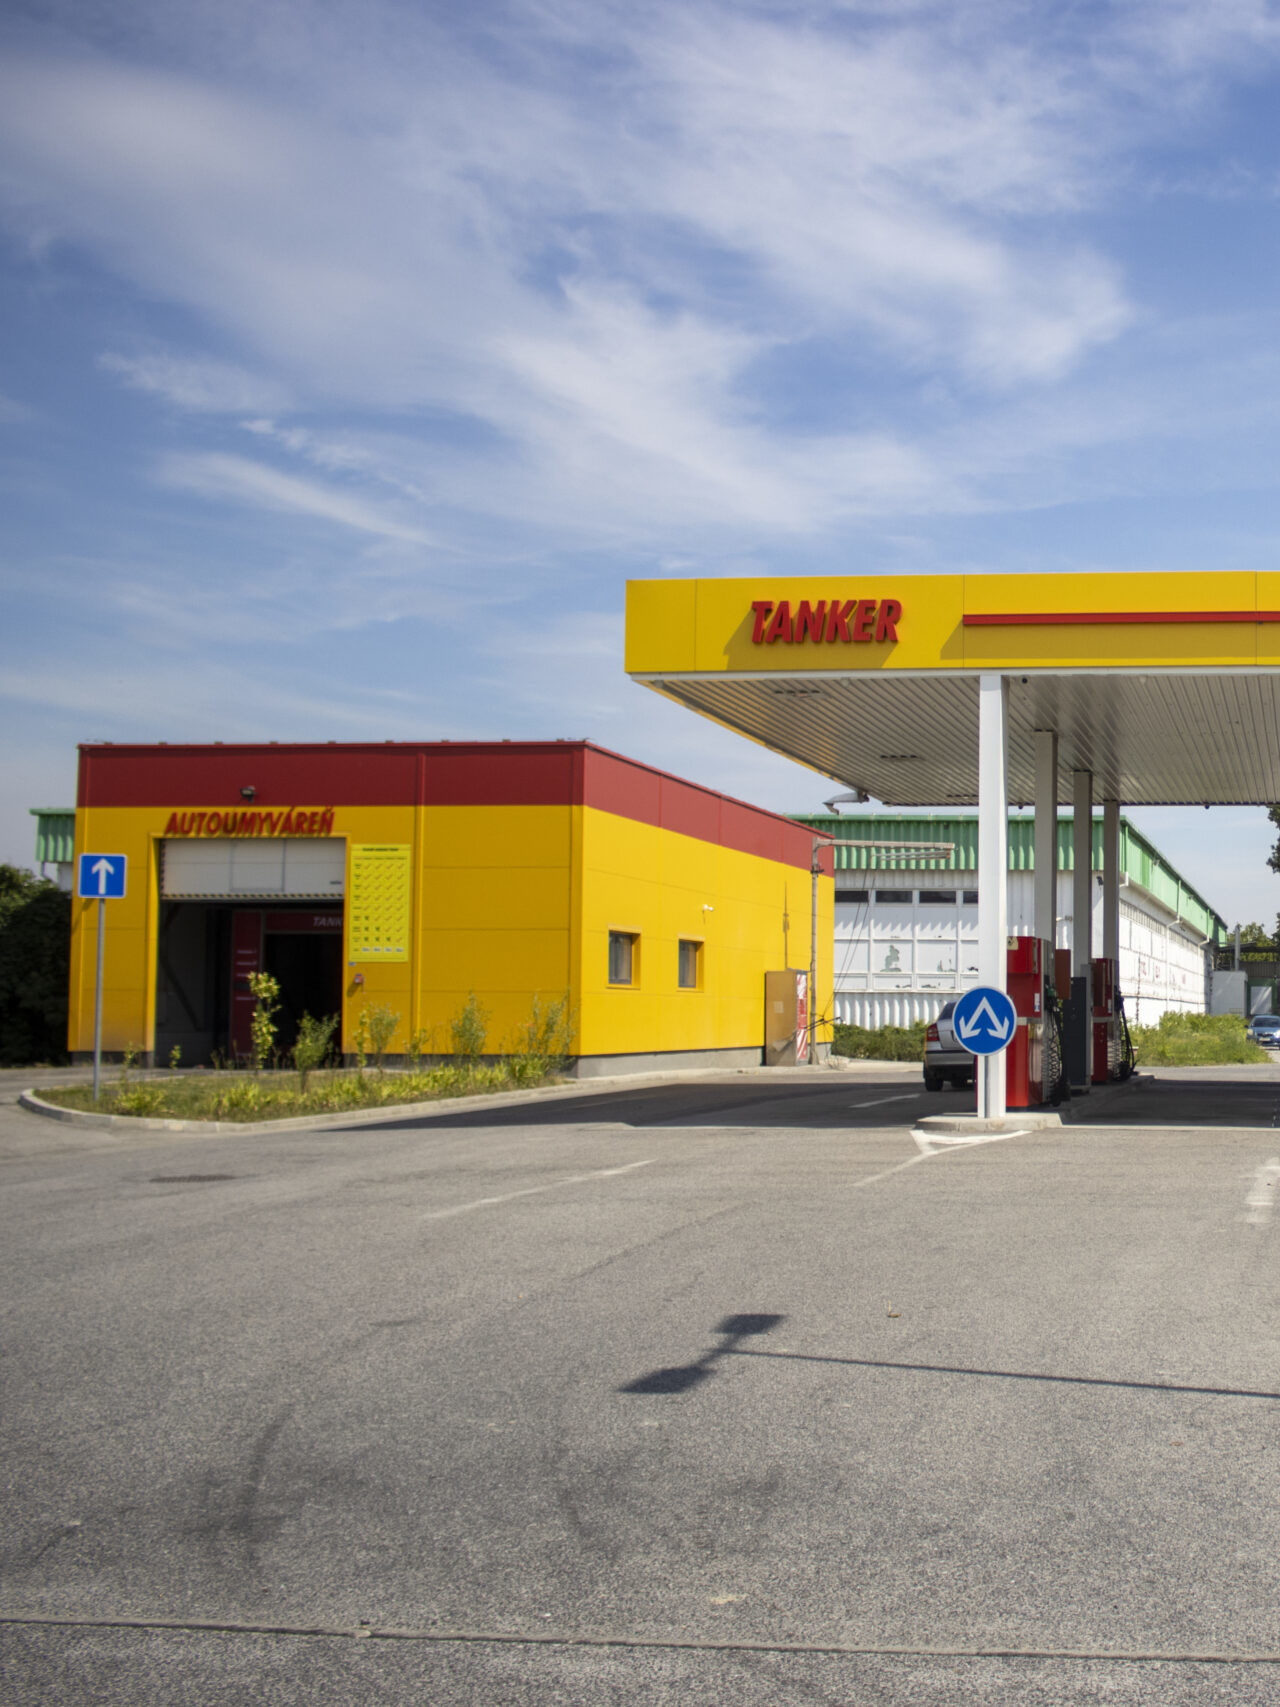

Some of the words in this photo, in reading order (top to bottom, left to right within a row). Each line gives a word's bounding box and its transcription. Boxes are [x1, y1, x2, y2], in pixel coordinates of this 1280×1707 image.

[751, 599, 903, 643] TANKER
[164, 805, 336, 835] AUTOUMYVÁREŇ
[313, 917, 342, 928] TANK
